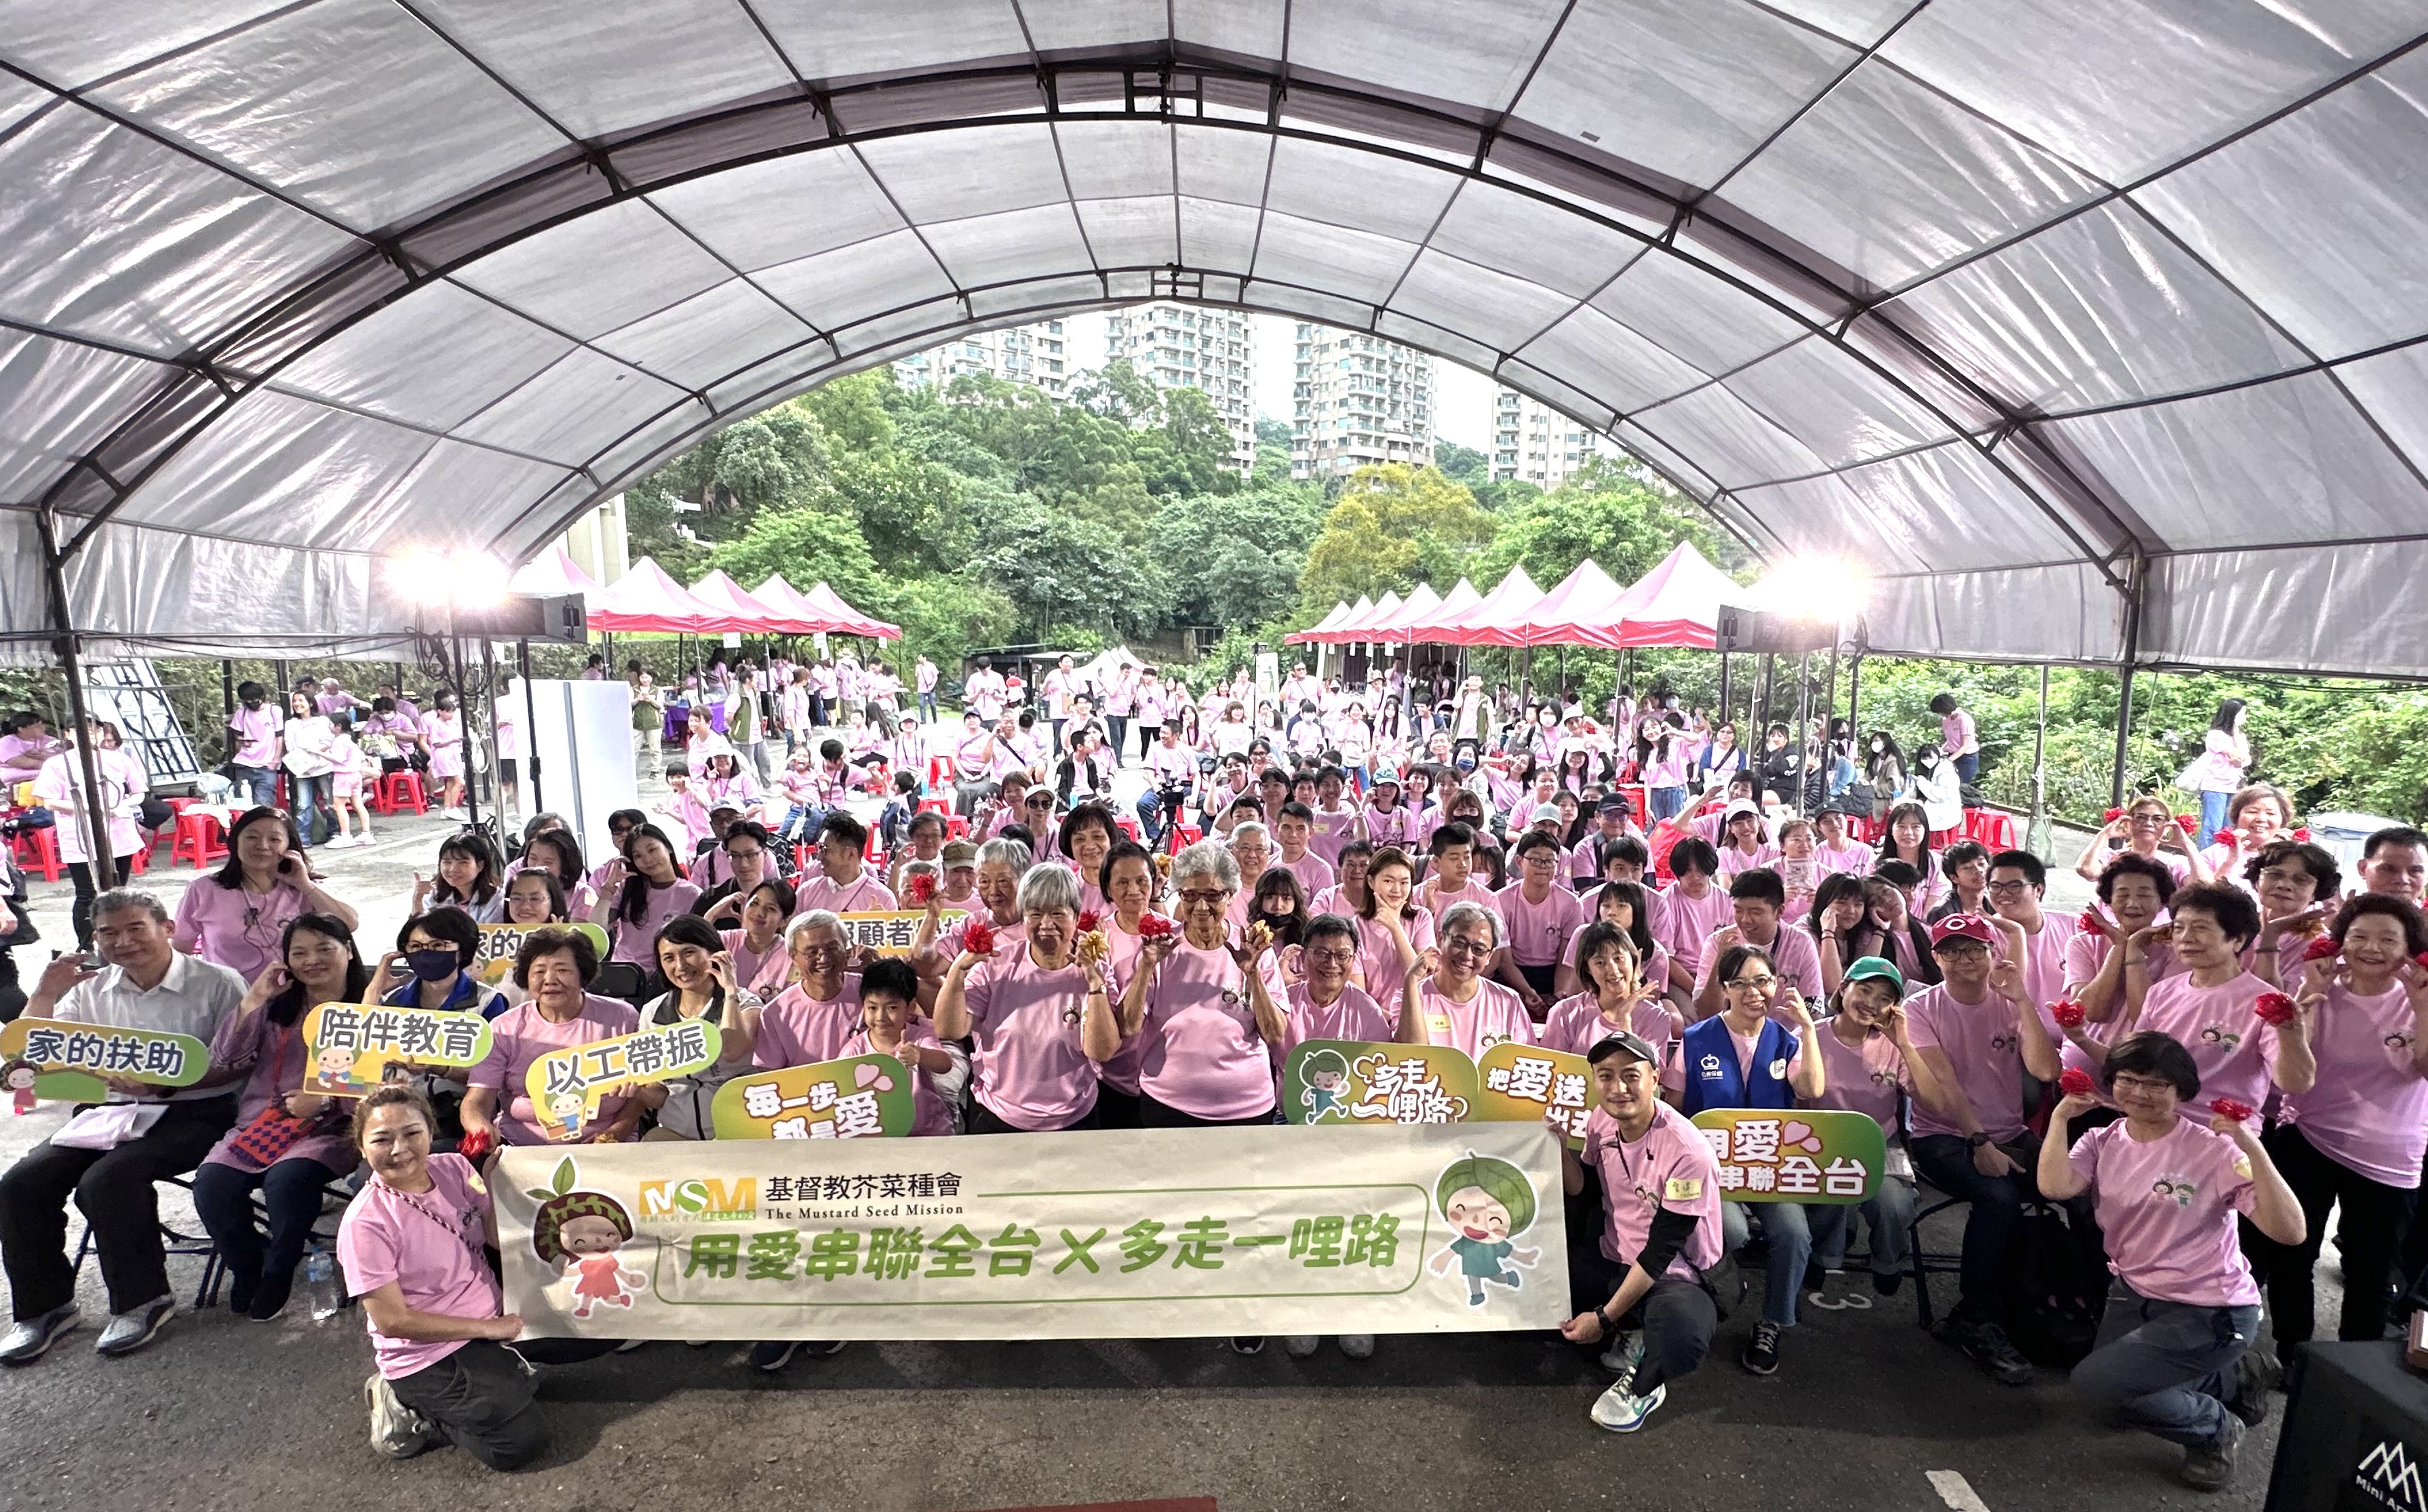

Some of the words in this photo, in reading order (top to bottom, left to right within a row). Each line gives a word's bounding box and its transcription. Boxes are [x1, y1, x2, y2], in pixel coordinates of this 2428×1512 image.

[26, 1029, 183, 1075] 家的扶助
[318, 1008, 480, 1058] 陪伴教育
[547, 1025, 706, 1093] 以工帶振
[744, 1082, 838, 1117] 每一步
[1487, 1056, 1586, 1107] 把愛送
[765, 1172, 962, 1201] 基督教芥菜種會
[1719, 1155, 1866, 1195] 串聯全台
[765, 1208, 792, 1219] The
[799, 1206, 859, 1219] Mustard
[866, 1204, 899, 1217] Seed
[906, 1203, 964, 1216] Mission
[2355, 1474, 2384, 1502] Mini
